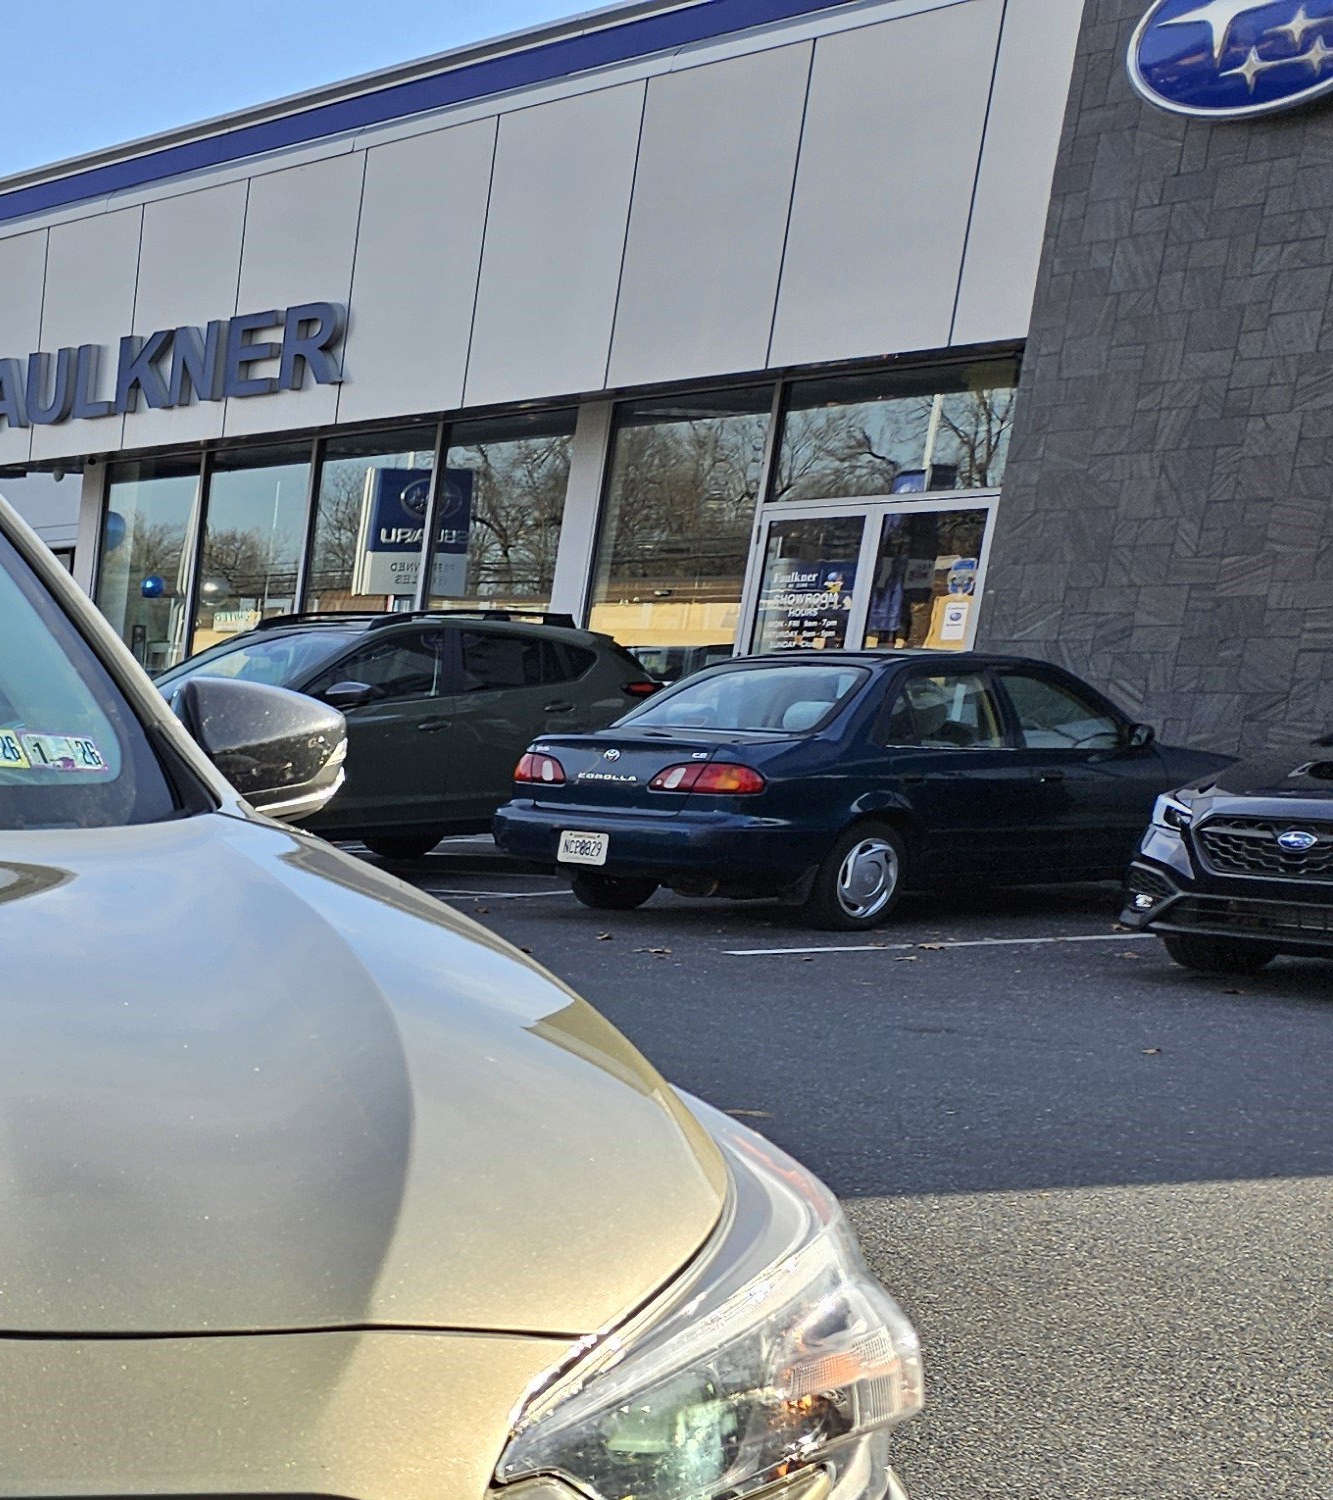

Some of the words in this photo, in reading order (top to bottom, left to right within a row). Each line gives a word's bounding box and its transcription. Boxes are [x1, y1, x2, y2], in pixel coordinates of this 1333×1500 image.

[773, 571, 819, 583] Faulkner
[773, 591, 839, 606] SHOWROOM
[787, 607, 819, 618] HOURS
[74, 740, 103, 766] 26
[578, 771, 637, 782] COROLLA
